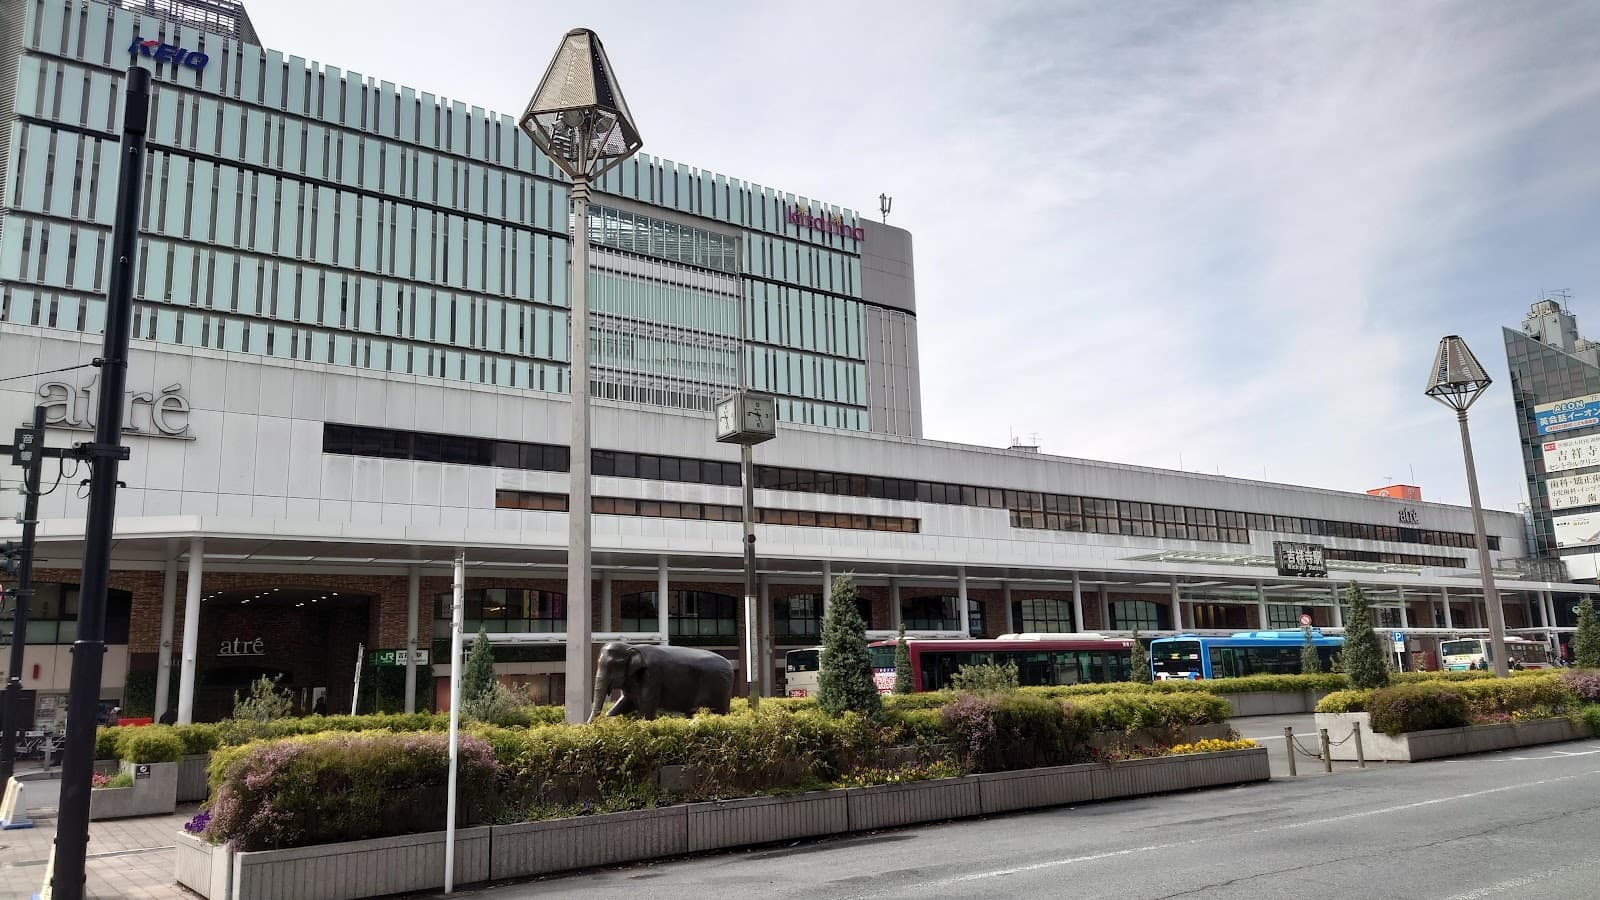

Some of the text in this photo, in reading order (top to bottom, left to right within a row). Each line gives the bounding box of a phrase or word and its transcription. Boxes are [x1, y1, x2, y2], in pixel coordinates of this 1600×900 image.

[128, 36, 209, 71] KEIO
[1554, 400, 1584, 413] AEON
[1557, 445, 1599, 462] 吉祥寺
[219, 637, 265, 654] atré
[380, 652, 395, 661] JR
